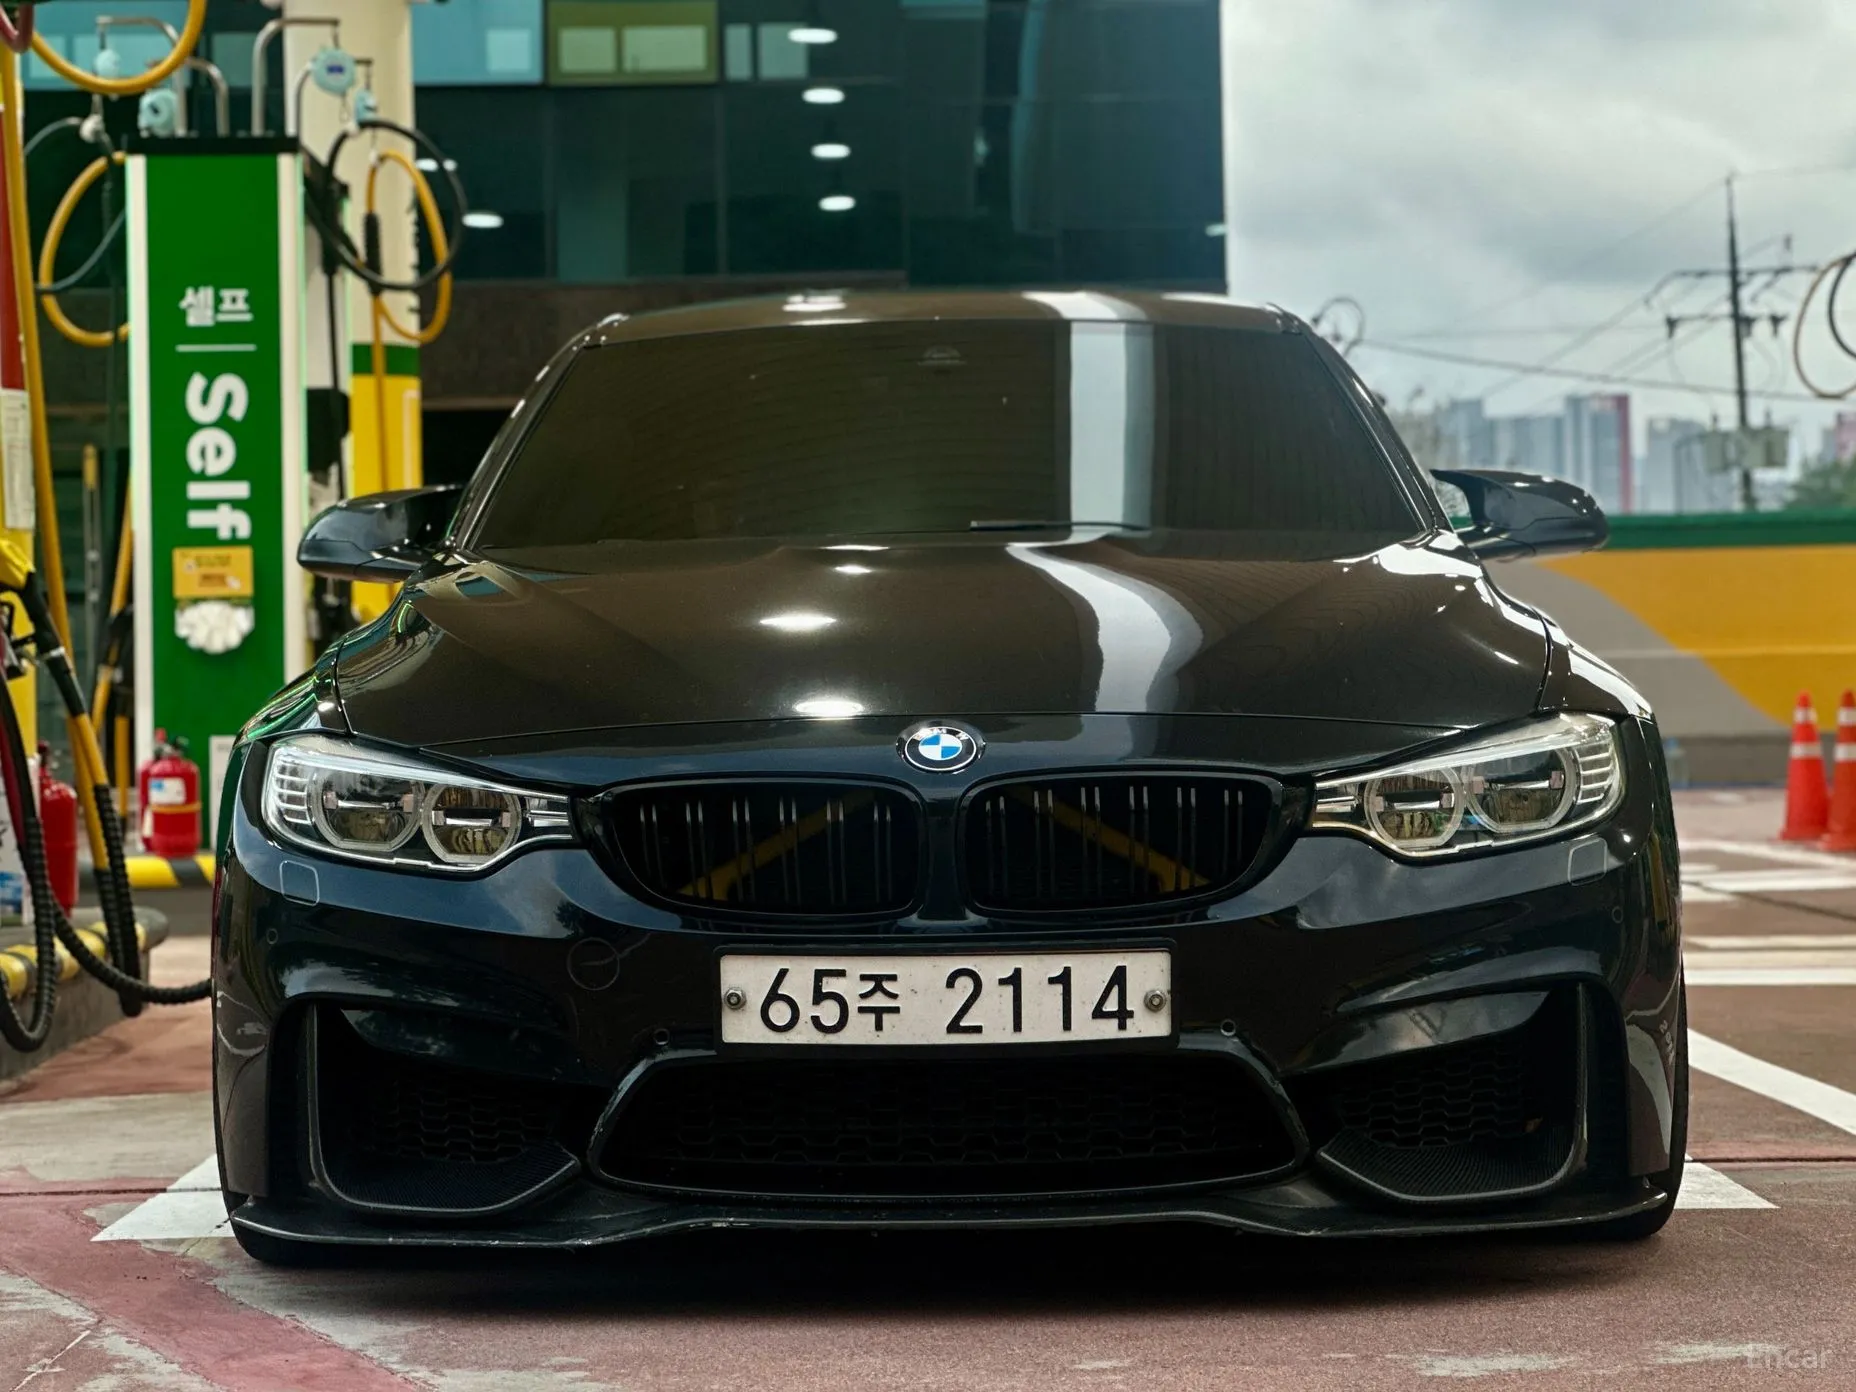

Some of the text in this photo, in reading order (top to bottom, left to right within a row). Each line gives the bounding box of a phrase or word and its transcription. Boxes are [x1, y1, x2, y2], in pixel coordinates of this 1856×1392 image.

[179, 285, 253, 326] 셀프
[186, 372, 251, 539] Self
[760, 965, 1134, 1035] 65주 2114
